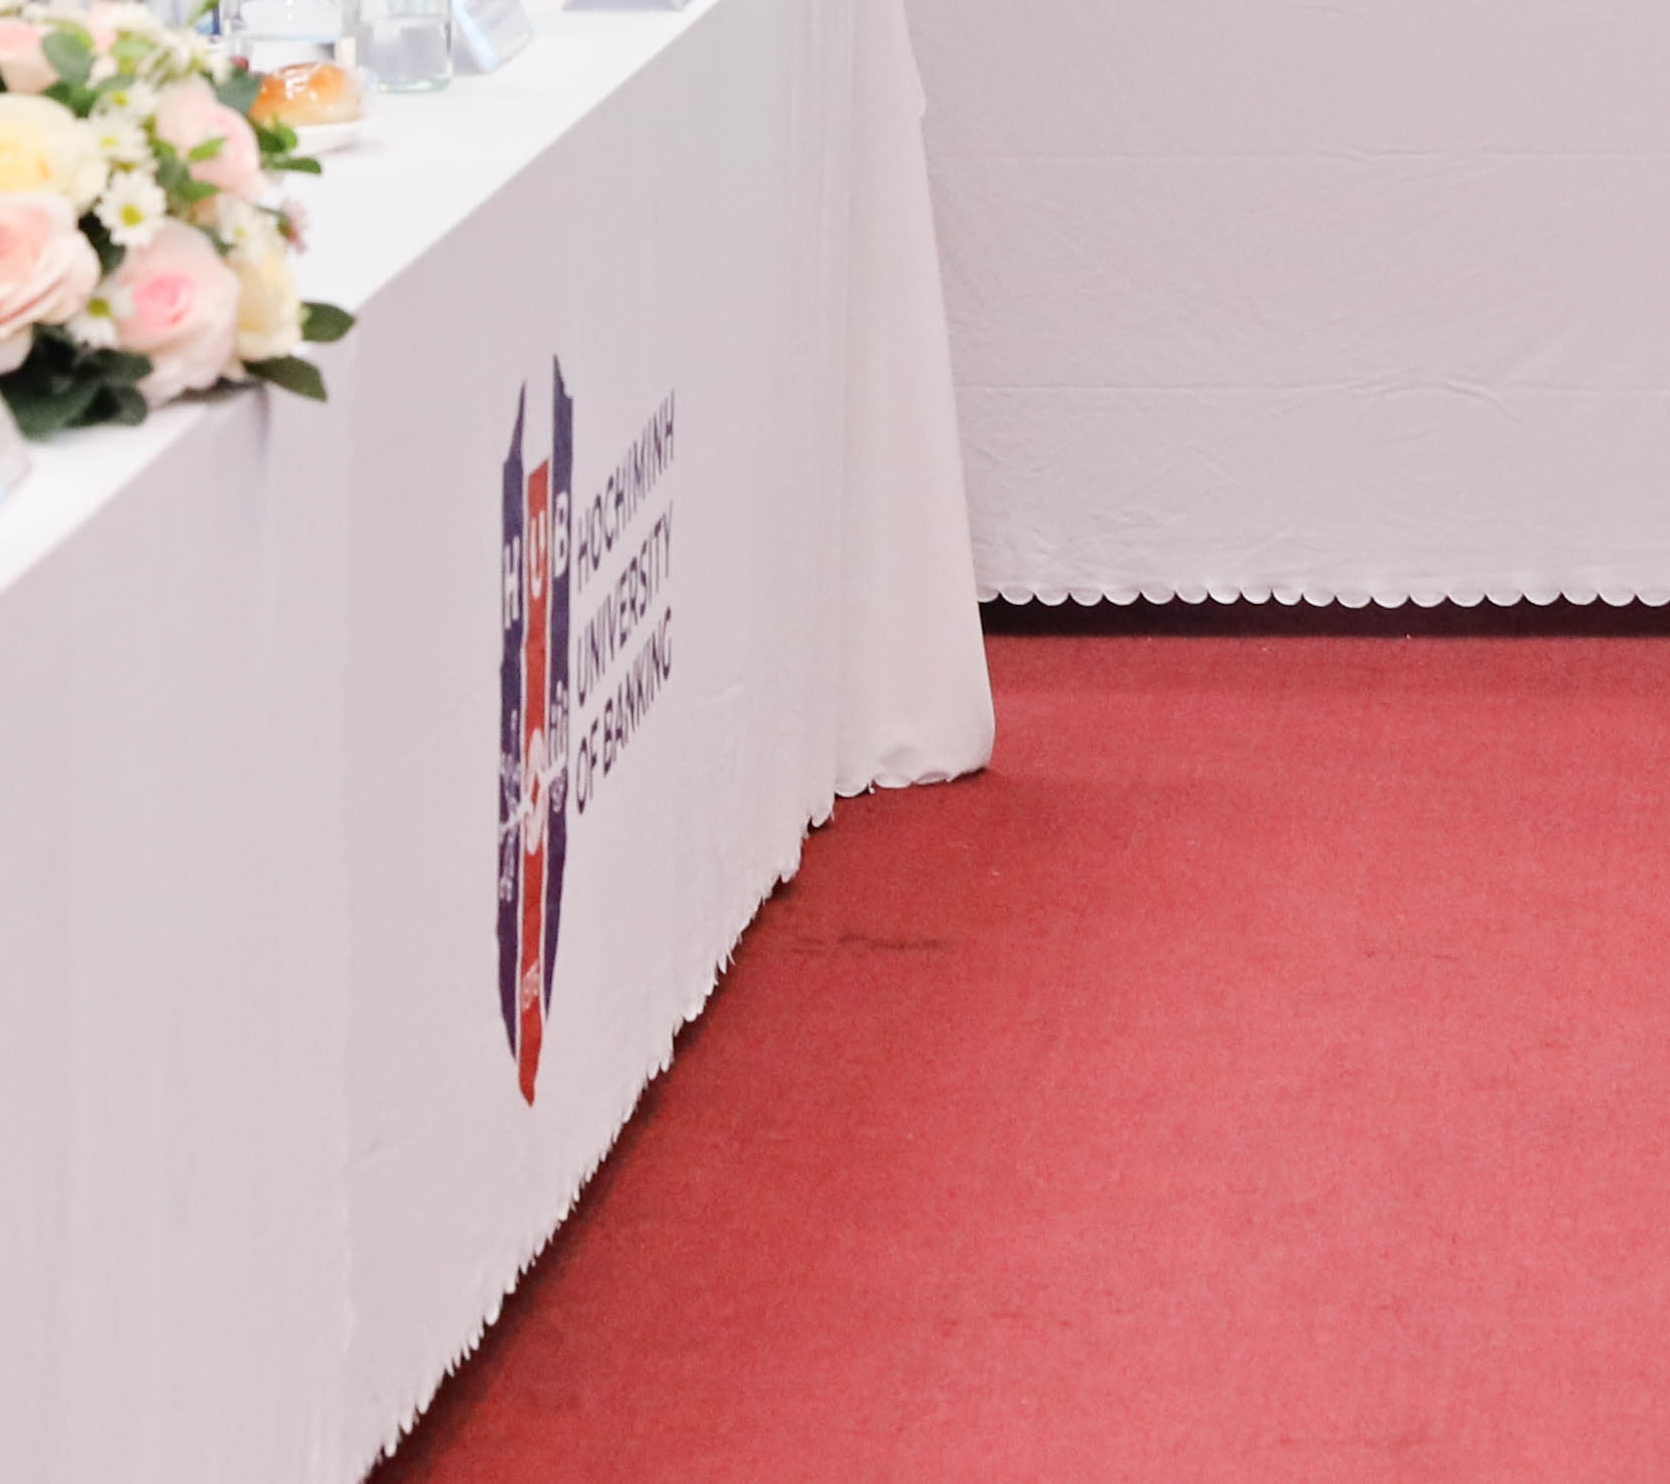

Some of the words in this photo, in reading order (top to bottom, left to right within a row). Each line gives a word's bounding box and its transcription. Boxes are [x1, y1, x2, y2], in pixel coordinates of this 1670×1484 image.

[504, 490, 569, 630] HUB
[577, 388, 675, 595] HOCHIMINH
[577, 499, 674, 707] UNIVERSITY
[576, 716, 599, 815] OF
[603, 606, 672, 777] BANKING
